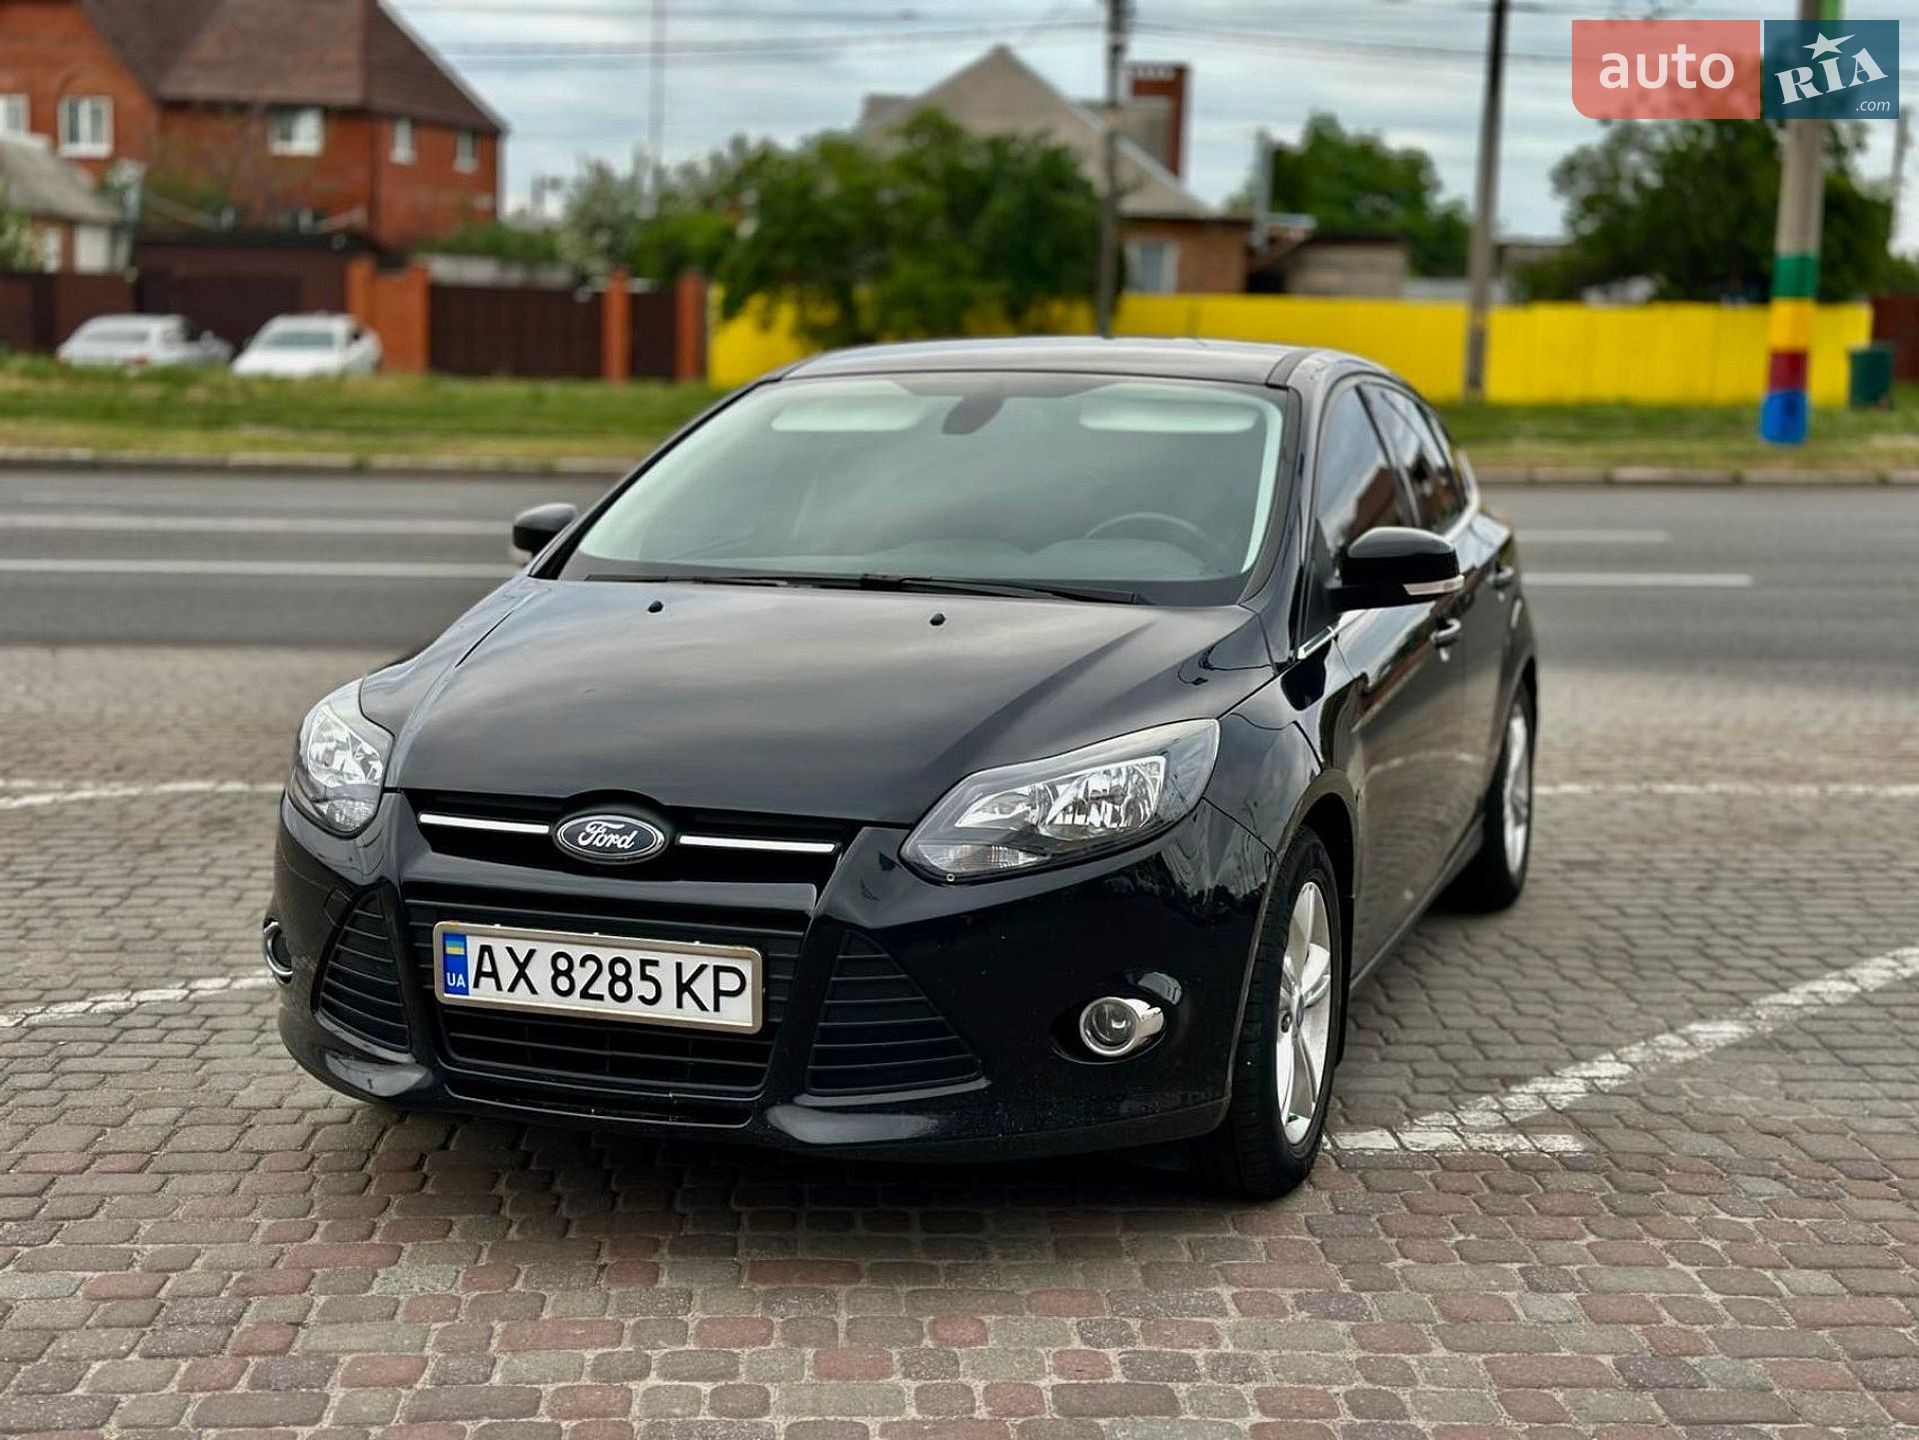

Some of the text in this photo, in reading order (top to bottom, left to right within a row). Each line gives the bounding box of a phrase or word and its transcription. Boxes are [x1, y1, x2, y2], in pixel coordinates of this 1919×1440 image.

[577, 820, 639, 849] Ford
[446, 944, 747, 1012] UA AX 8285 KP
